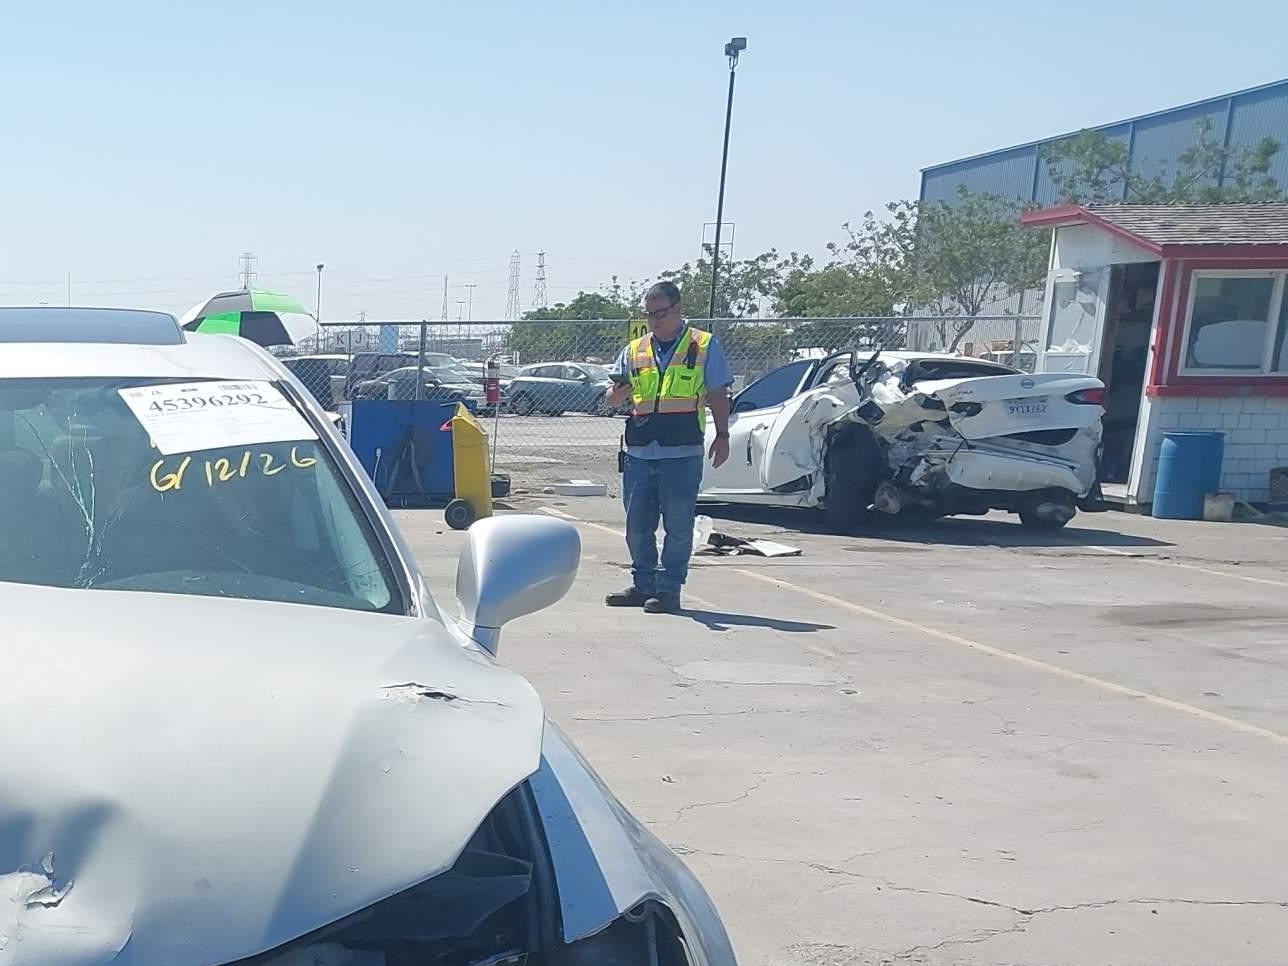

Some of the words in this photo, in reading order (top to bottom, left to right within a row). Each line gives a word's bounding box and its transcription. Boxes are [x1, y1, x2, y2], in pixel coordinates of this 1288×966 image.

[632, 324, 648, 339] 10
[336, 334, 345, 345] K
[354, 333, 362, 344] J
[149, 393, 268, 412] 45396292
